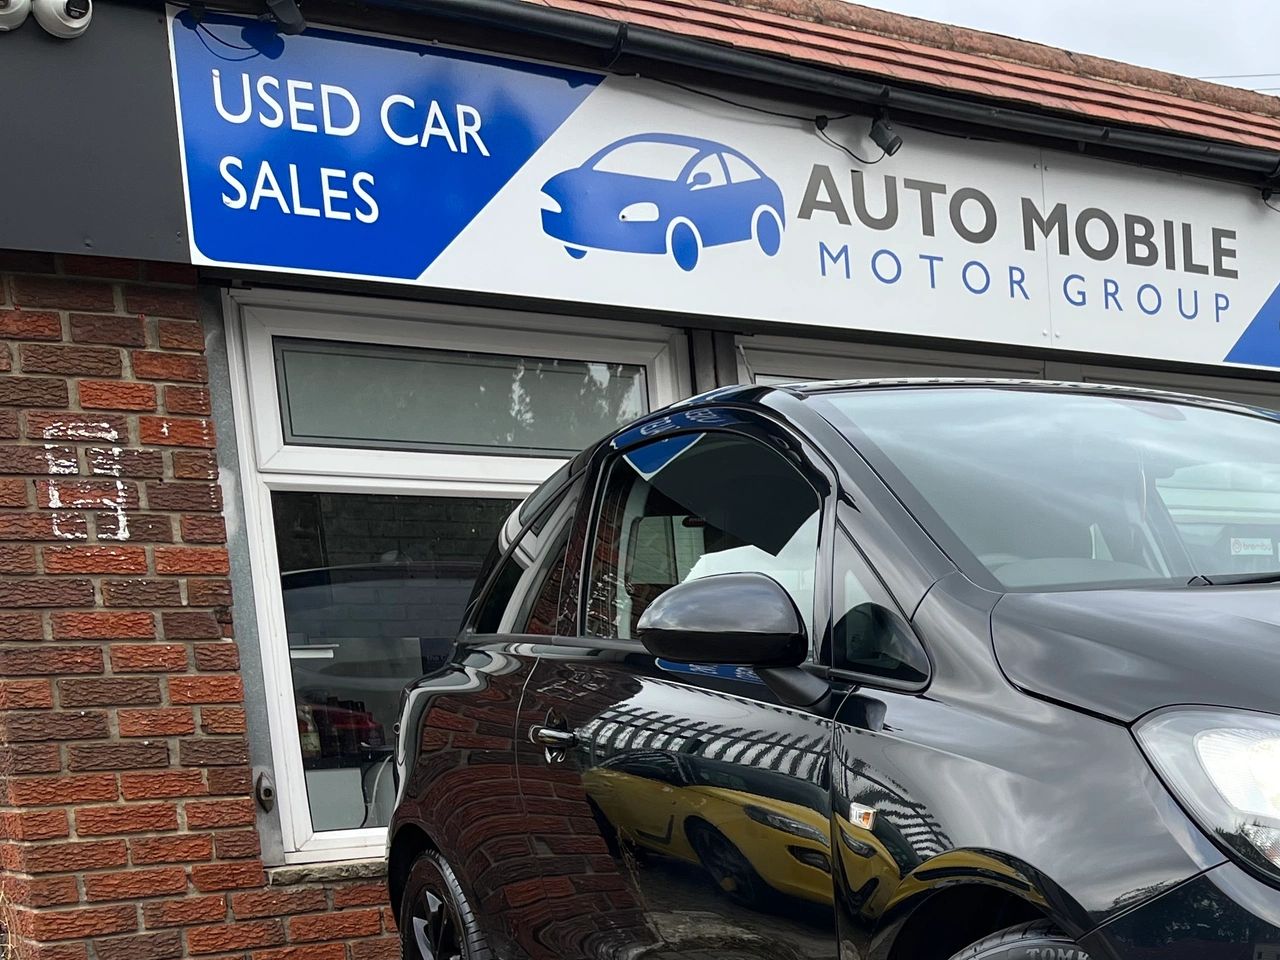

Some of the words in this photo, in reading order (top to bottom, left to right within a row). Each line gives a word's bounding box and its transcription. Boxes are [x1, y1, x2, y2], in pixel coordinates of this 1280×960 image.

[212, 69, 361, 137] USED
[380, 94, 490, 157] CAR
[219, 155, 379, 224] SALES
[797, 163, 998, 244] AUTO
[1020, 197, 1239, 279] MOBILE
[818, 241, 1030, 301] MOTOR
[1062, 274, 1230, 323] GROUP
